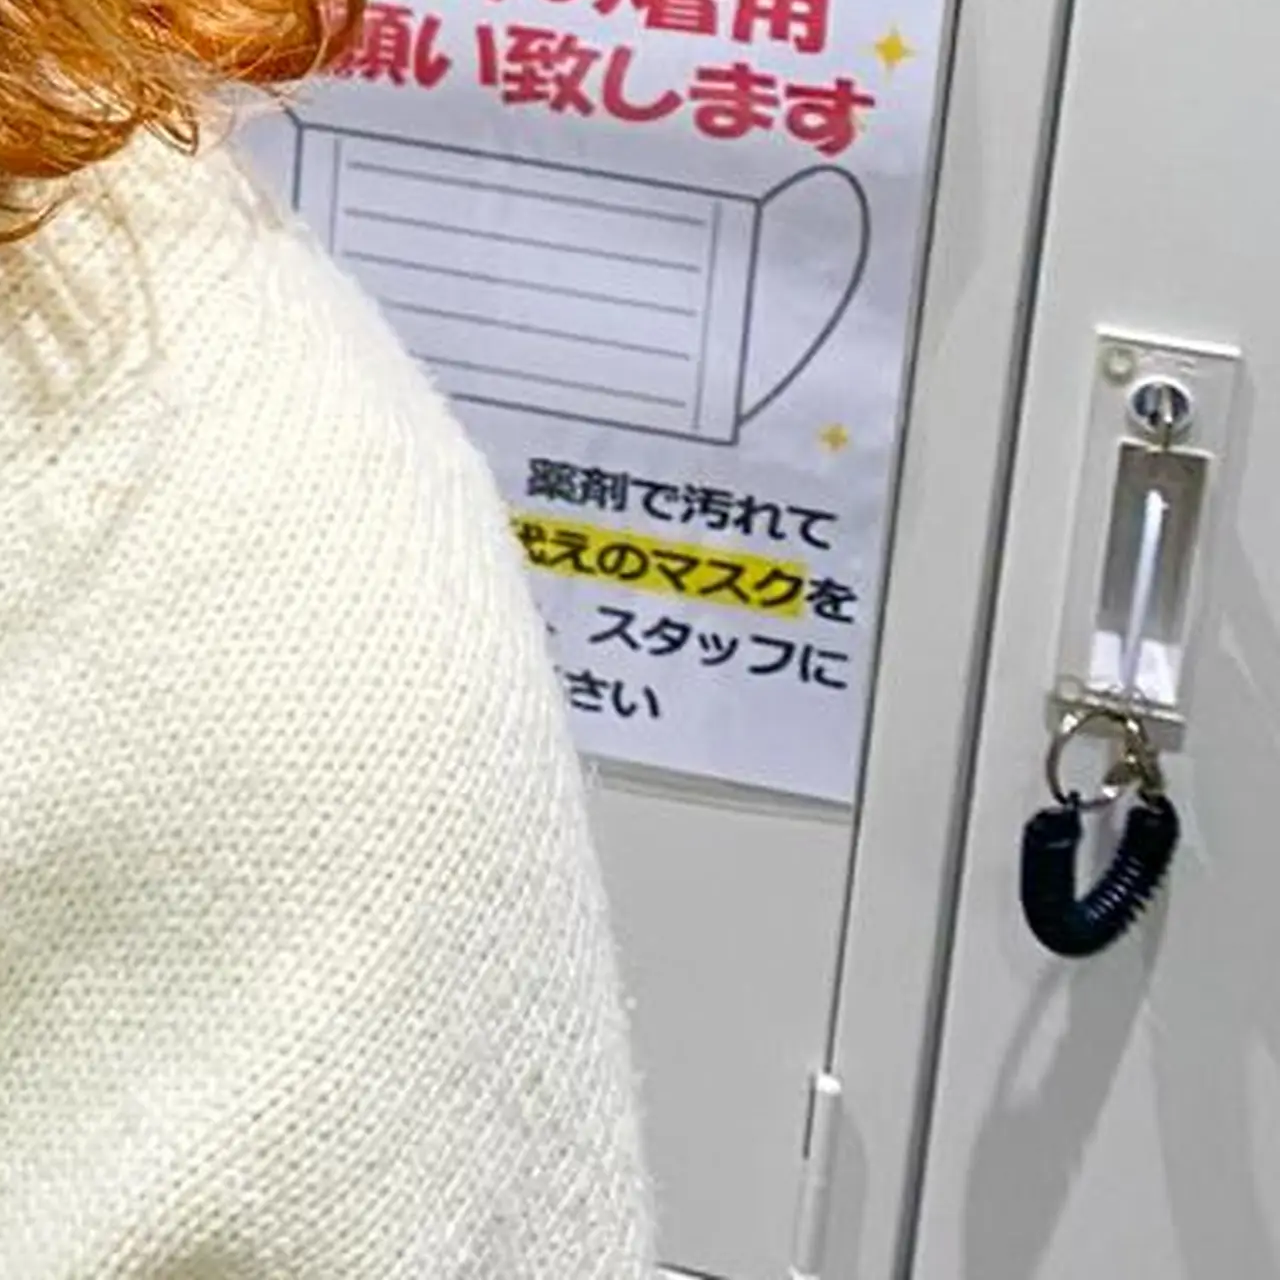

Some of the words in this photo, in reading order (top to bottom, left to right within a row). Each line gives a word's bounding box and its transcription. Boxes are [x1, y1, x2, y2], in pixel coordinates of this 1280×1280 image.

[526, 457, 837, 551] 薬剤で汚れて
[554, 662, 661, 718] さい
